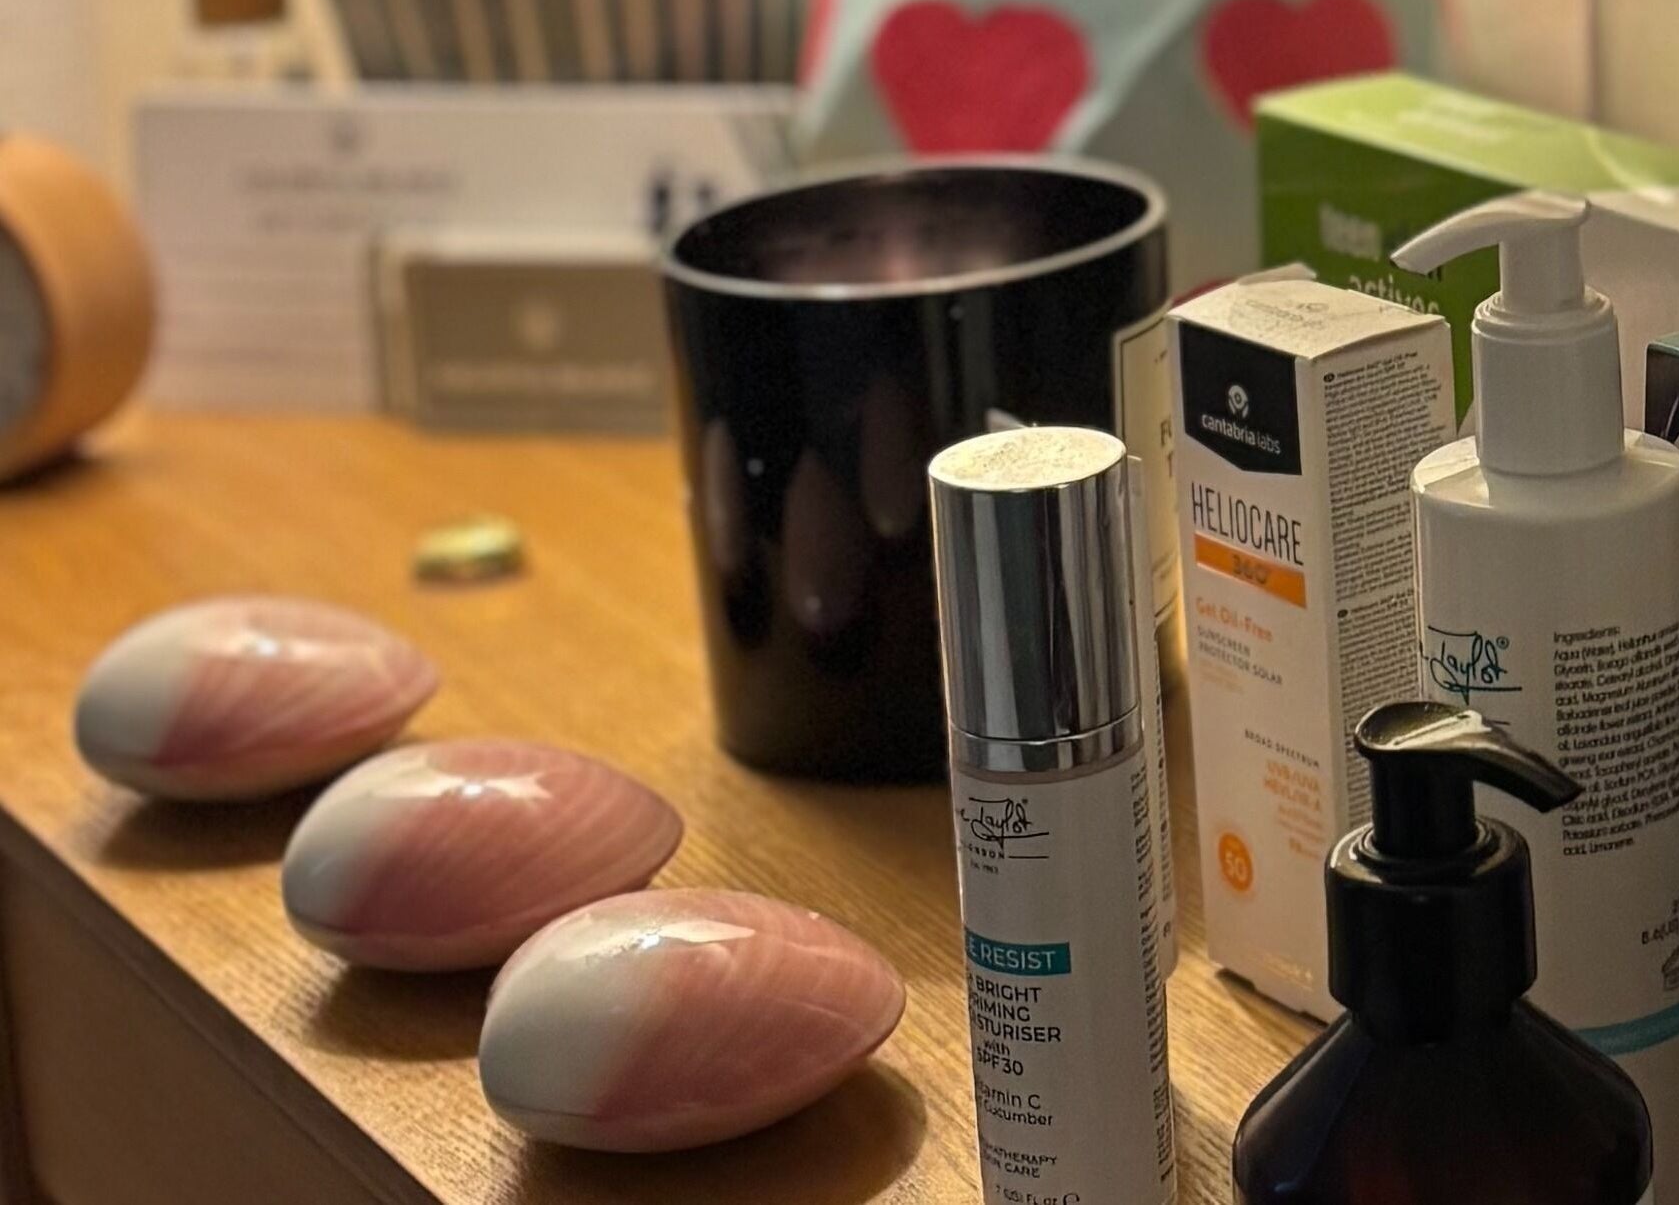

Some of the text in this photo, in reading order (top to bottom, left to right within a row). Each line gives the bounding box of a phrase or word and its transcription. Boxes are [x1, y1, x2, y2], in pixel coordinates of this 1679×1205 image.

[1202, 413, 1281, 455] cantabria labs
[1191, 480, 1304, 566] HELIOCARE
[1253, 664, 1283, 685] SOLAR
[1224, 852, 1248, 879] 50
[980, 942, 1056, 970] RESIST
[976, 975, 1042, 1003] BRIGHT
[974, 1012, 1061, 1043] STURISER
[1028, 1094, 1041, 1110] C
